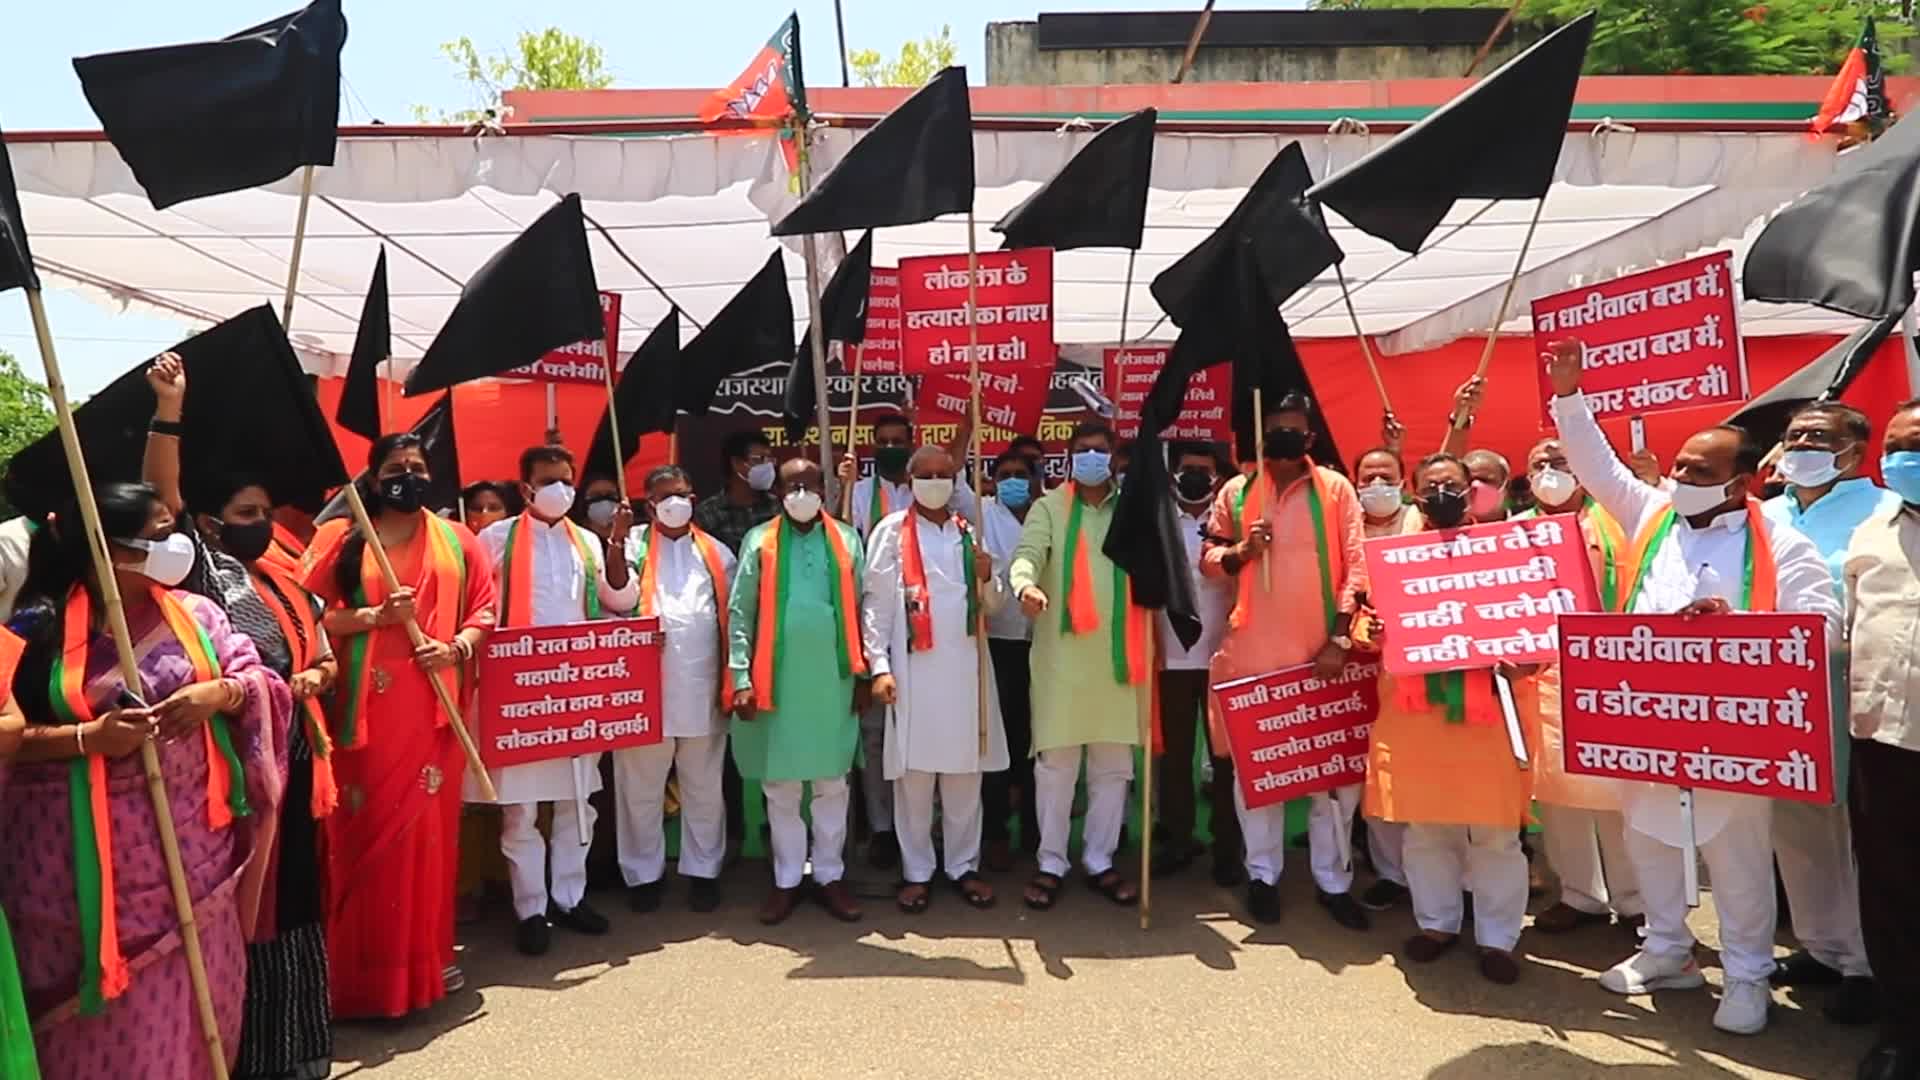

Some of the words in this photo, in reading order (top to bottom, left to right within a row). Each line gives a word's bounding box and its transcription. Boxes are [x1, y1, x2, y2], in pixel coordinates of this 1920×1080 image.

[1005, 260, 1029, 285] के
[975, 306, 1003, 325] का
[1005, 303, 1049, 323] नाश
[1537, 311, 1556, 332] न
[1558, 292, 1648, 328] धारीवाल
[1650, 278, 1692, 307] बस
[928, 339, 950, 365] हो
[1649, 328, 1692, 355] बस
[715, 376, 787, 397] राजस्था
[1627, 378, 1694, 408] संकट
[1381, 534, 1498, 564] गहलोत
[1501, 521, 1564, 549] तेरी
[1401, 556, 1557, 595] तानाशाही
[1399, 601, 1468, 628] नहीं
[1474, 588, 1576, 620] चलेगी
[537, 639, 568, 655] रात
[571, 631, 596, 650] को
[600, 627, 652, 649] महिला
[1403, 634, 1473, 663] नहीं
[1567, 635, 1590, 660] न
[1594, 625, 1713, 664] धारीवाल
[1716, 637, 1772, 665] बस
[1776, 626, 1816, 671] में,
[514, 662, 579, 686] महापौर
[1272, 681, 1300, 700] रात
[501, 694, 566, 718] गहलोत
[1256, 704, 1318, 732] महापौर
[1574, 688, 1598, 714] न
[1600, 680, 1710, 722] डोटसरा
[1713, 696, 1770, 726] बस
[1773, 688, 1813, 733] में,
[496, 727, 568, 750] लोकतंत्र
[571, 719, 597, 740] की
[1251, 736, 1312, 763] गहलोत
[1313, 723, 1374, 748] हाय-हा
[1252, 766, 1319, 792] लोकतंत्र
[1321, 754, 1345, 775] की
[1576, 741, 1678, 777] सरकार
[1681, 746, 1771, 785] संकट
